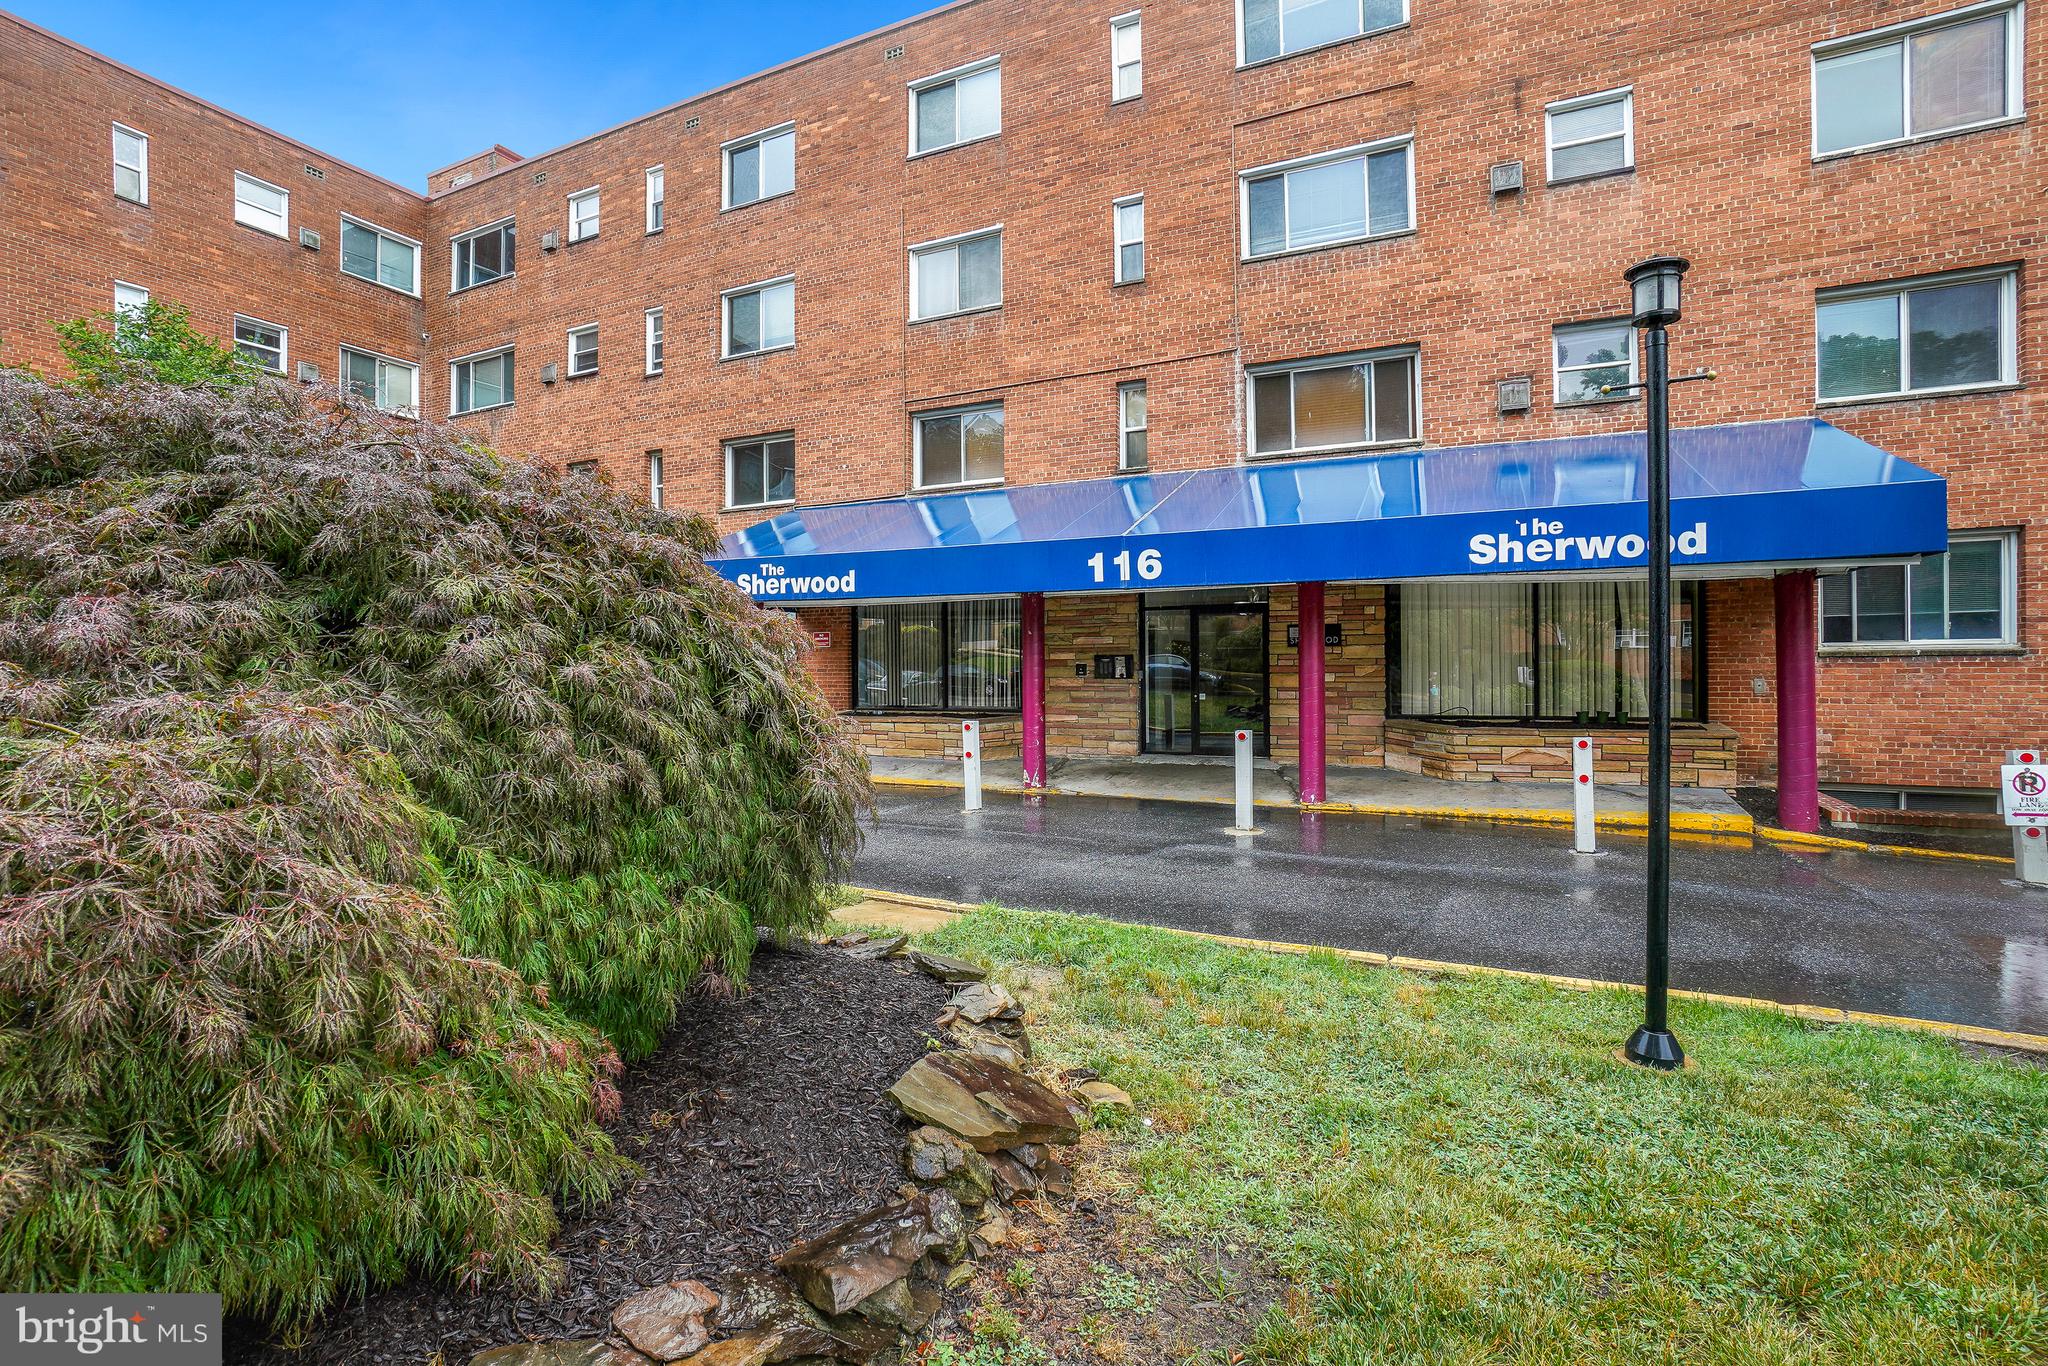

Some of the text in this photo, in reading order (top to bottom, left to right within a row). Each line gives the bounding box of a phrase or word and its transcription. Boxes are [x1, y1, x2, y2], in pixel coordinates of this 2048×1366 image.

[1468, 522, 1707, 565] Sherwod
[759, 563, 785, 576] The
[1087, 548, 1163, 583] 116
[737, 569, 856, 595] Sherwood
